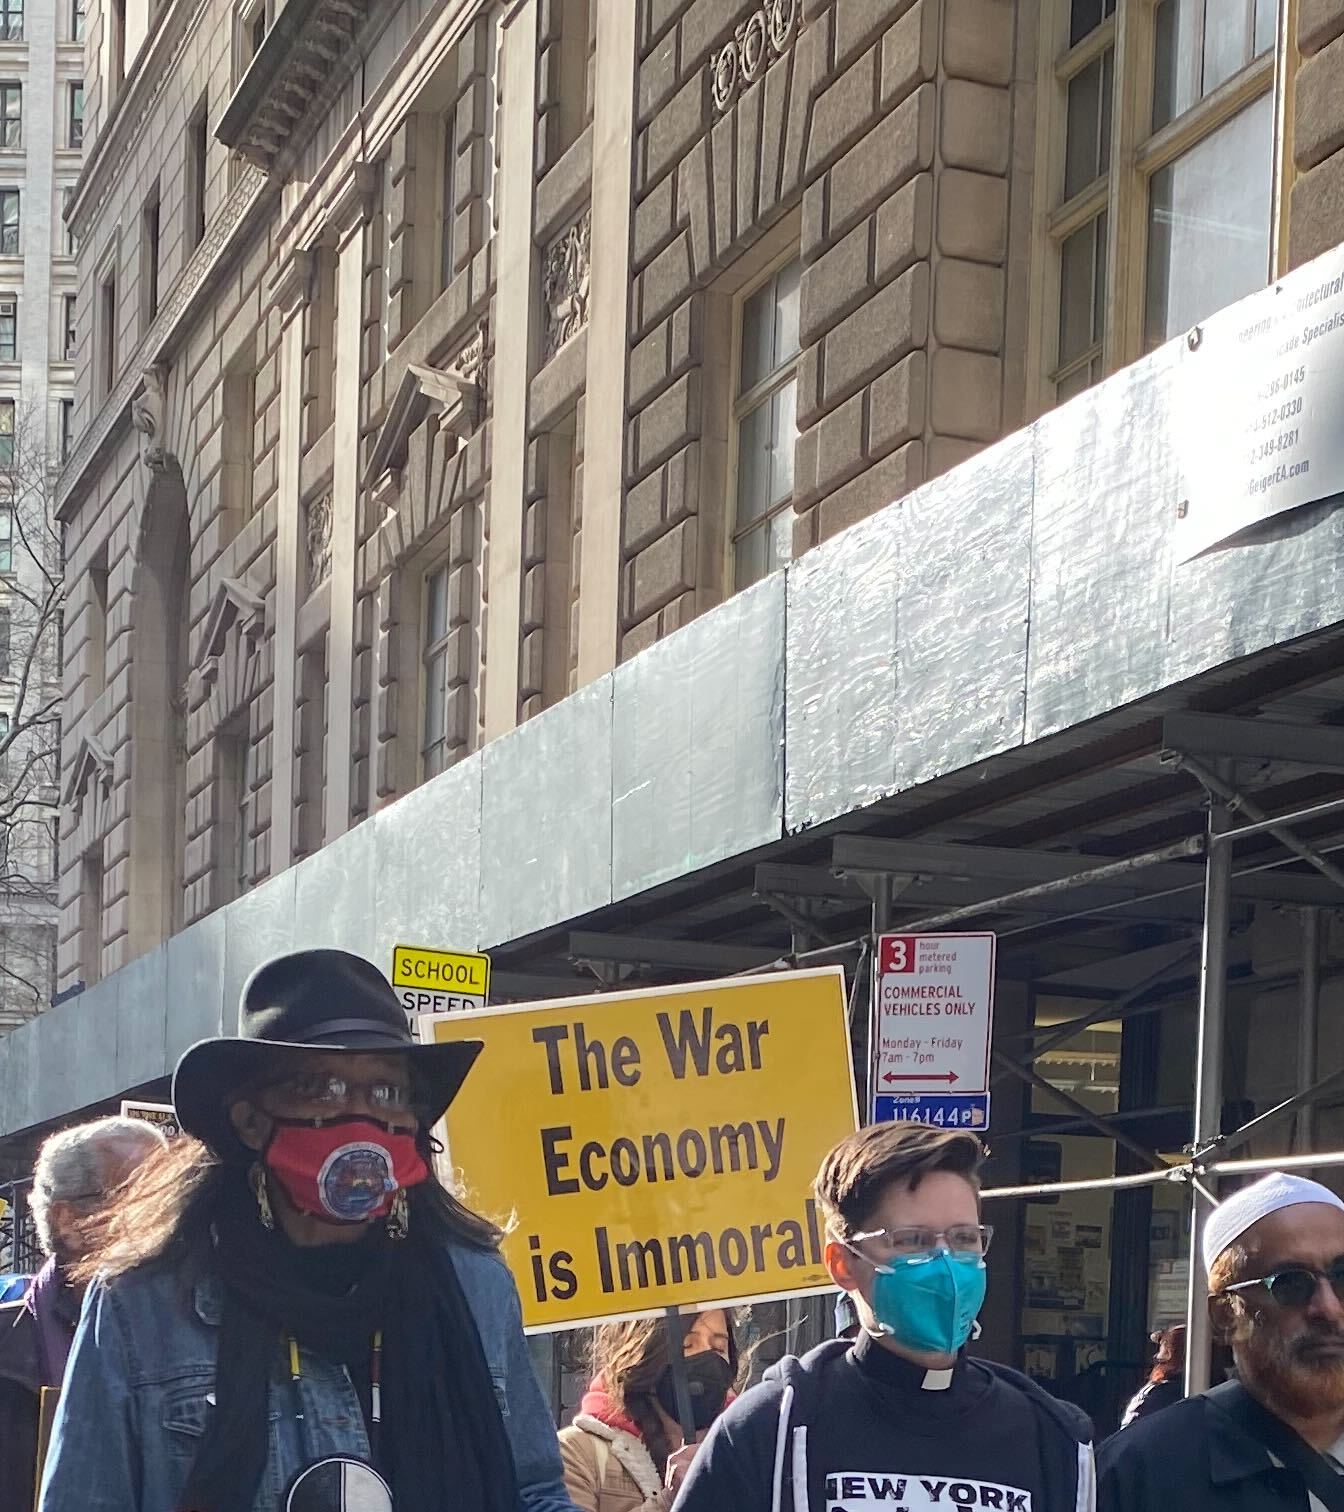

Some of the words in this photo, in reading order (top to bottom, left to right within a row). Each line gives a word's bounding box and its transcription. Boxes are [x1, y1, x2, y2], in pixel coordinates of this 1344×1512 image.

[919, 941, 940, 950] hour
[889, 940, 907, 972] 3
[919, 952, 957, 962] metered
[401, 958, 480, 985] SCHOOL
[919, 964, 953, 976] parking
[884, 985, 964, 999] COMMERCIAL
[884, 1003, 941, 1016] VEHICLES
[945, 1002, 976, 1016] ONLY
[532, 1022, 642, 1095] The
[656, 1006, 770, 1079] War
[882, 1038, 921, 1050] Monday
[931, 1037, 963, 1049] Friday
[883, 1053, 904, 1063] 7am
[914, 1053, 935, 1065] 7pm
[540, 1117, 786, 1197] Economy
[529, 1235, 578, 1303] is
[594, 1198, 823, 1294] Immoral
